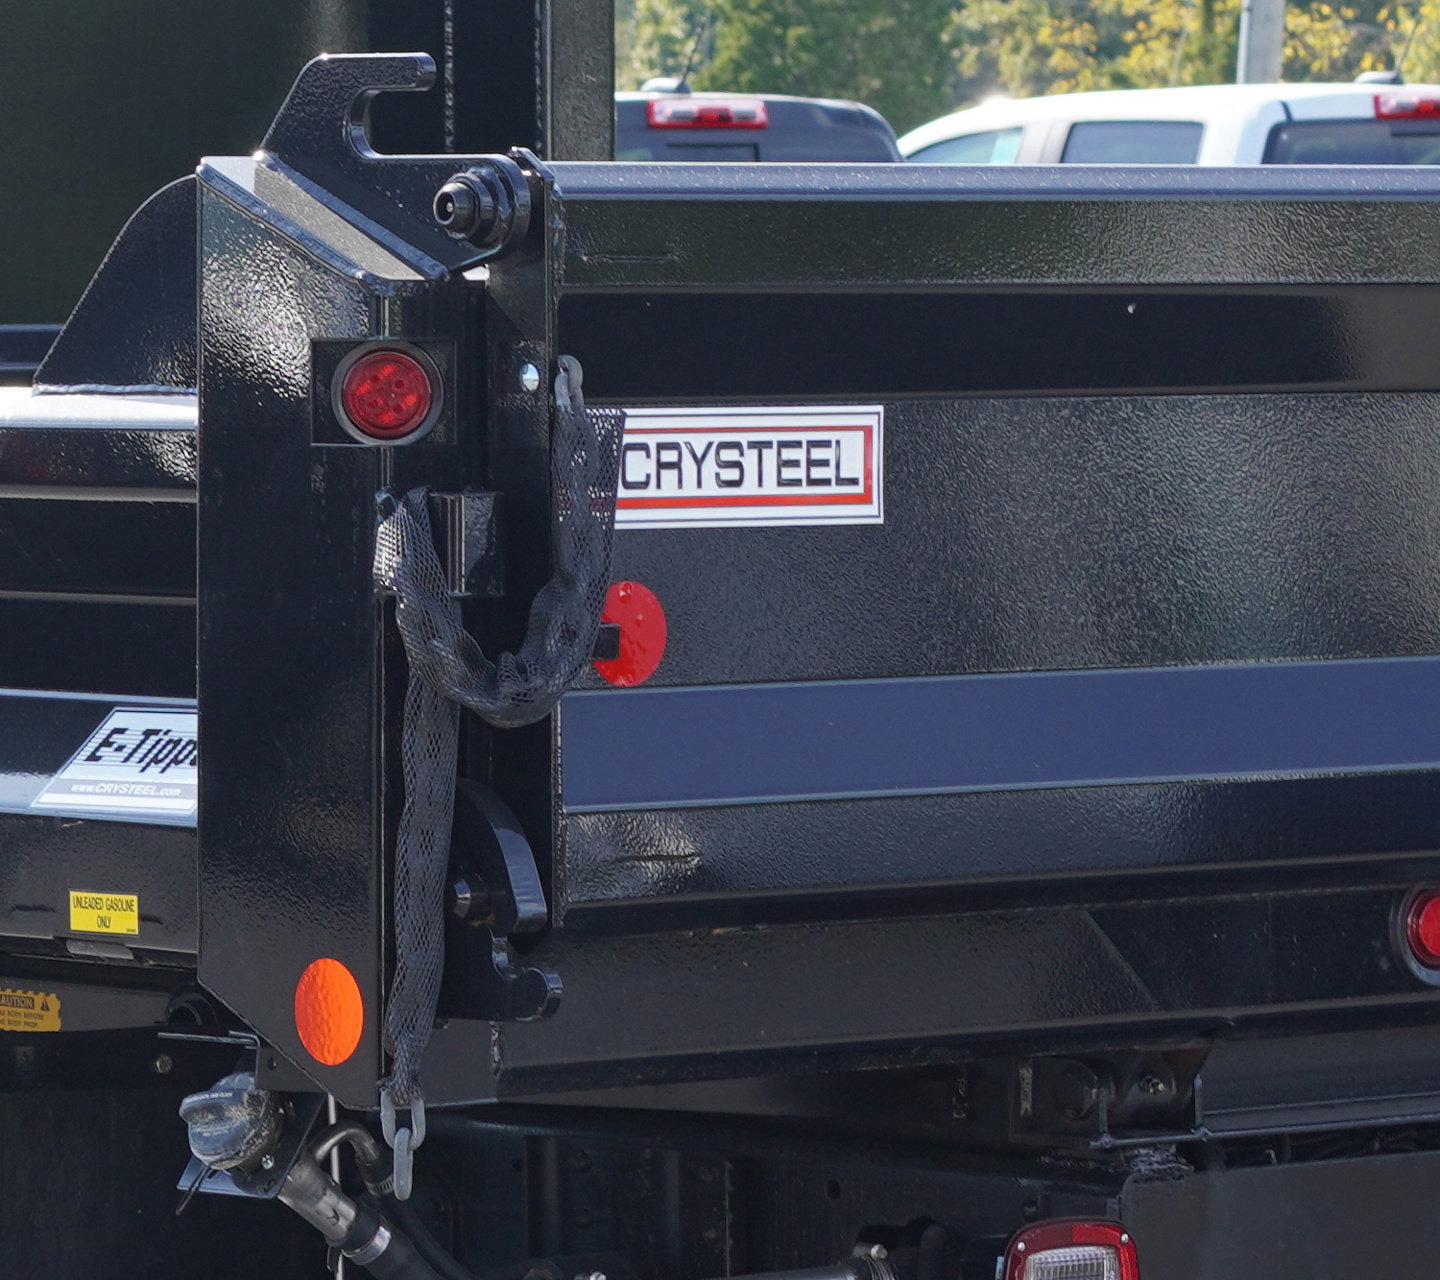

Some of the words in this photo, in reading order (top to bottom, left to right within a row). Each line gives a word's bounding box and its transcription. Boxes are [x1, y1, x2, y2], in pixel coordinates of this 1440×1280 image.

[621, 439, 859, 490] CRYSTEEL
[84, 727, 197, 774] E-Tipp
[72, 782, 182, 796] www.CRYSTEEL.com
[73, 895, 103, 910] UNLEADED
[106, 897, 135, 913] GASOLINE
[96, 914, 111, 928] ONLY
